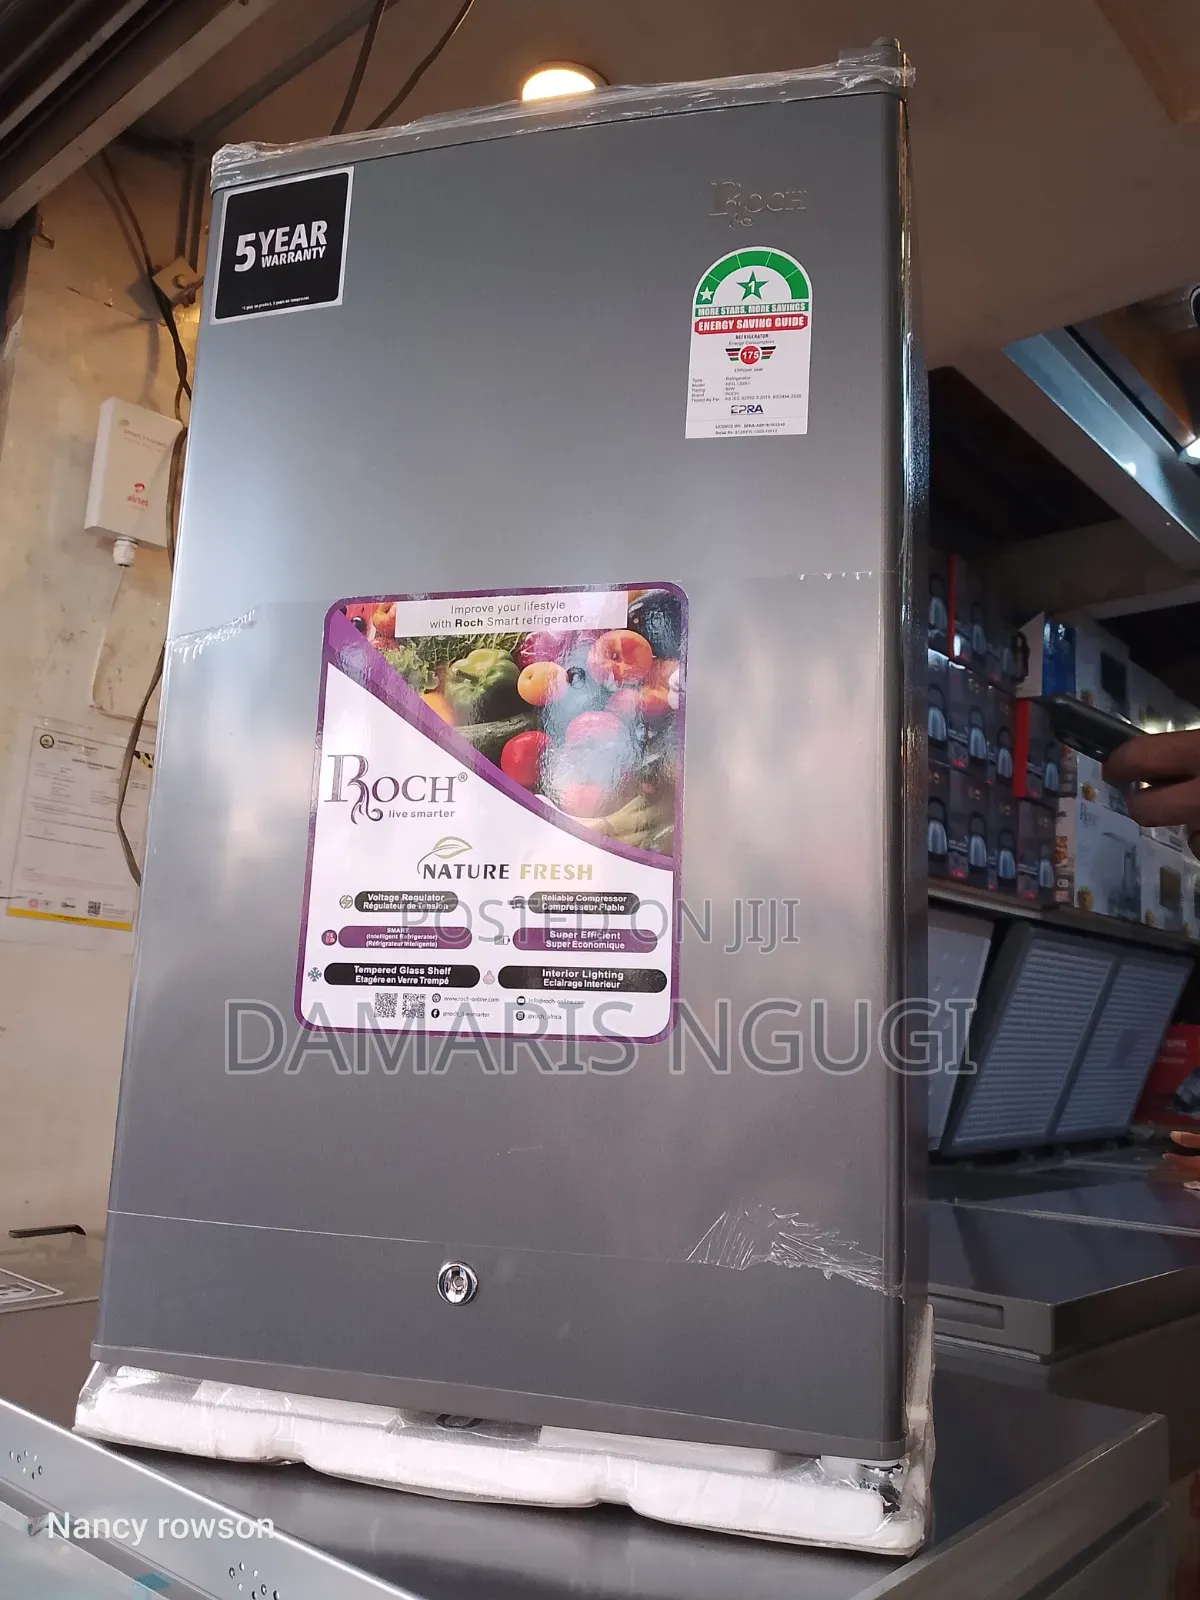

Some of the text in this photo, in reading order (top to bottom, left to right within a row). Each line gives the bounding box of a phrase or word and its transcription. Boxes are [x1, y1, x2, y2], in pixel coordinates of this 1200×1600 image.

[234, 220, 328, 272] 5 YEAR
[261, 246, 326, 268] WARRANTY
[748, 280, 756, 294] 1
[698, 302, 806, 316] MORE STARS, MORE SAVINGS
[698, 316, 805, 331] ENERGY SAVING GUIDE
[742, 350, 759, 360] 175
[731, 404, 764, 414] EPRA
[127, 494, 149, 507] airtel
[451, 600, 566, 616] Improve your lifestyle
[430, 614, 587, 629] with Roch Smart refrigerator.
[388, 809, 455, 818] live smarter
[423, 863, 593, 881] NATURE FRESH
[367, 893, 445, 903] Voltage Regulator
[541, 894, 628, 904] Reliable Compressor
[407, 902, 416, 910] de
[418, 902, 449, 911] Tension
[542, 903, 625, 912] Compresseur Fiable
[549, 930, 621, 941] Super Efficient
[545, 940, 625, 950] Super Economique
[354, 965, 451, 976] Tempered Glass Shelf
[542, 969, 624, 981] Interior Lighting
[397, 976, 418, 984] Verre
[420, 976, 449, 986] Trempé
[543, 979, 620, 989] Eclairage Interieur
